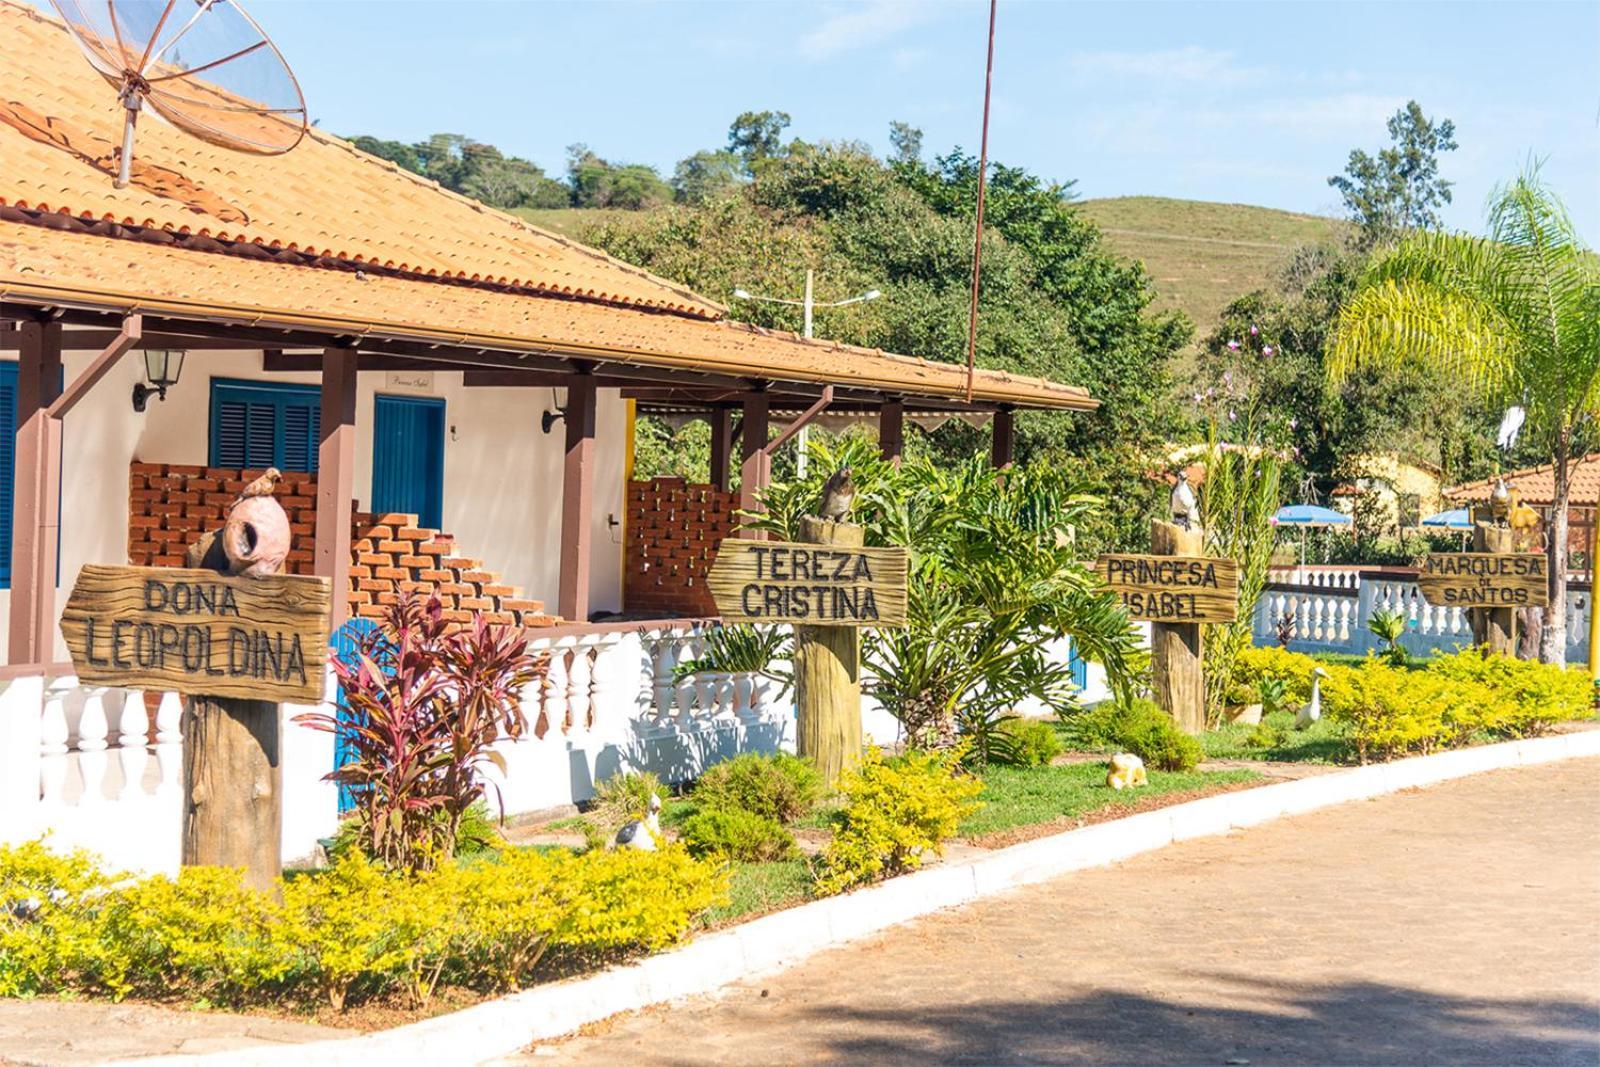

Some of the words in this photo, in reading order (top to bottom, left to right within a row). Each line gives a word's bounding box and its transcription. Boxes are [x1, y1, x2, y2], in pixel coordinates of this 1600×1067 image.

[748, 547, 873, 582] TEREZA
[1107, 558, 1218, 588] PRINCESA
[1427, 557, 1542, 576] MARQUESA
[144, 580, 239, 616] DONA
[1444, 587, 1528, 603] SANTOS
[1478, 578, 1492, 587] DE
[742, 583, 880, 620] CRISTINA
[85, 617, 308, 685] LEOPOLDINA
